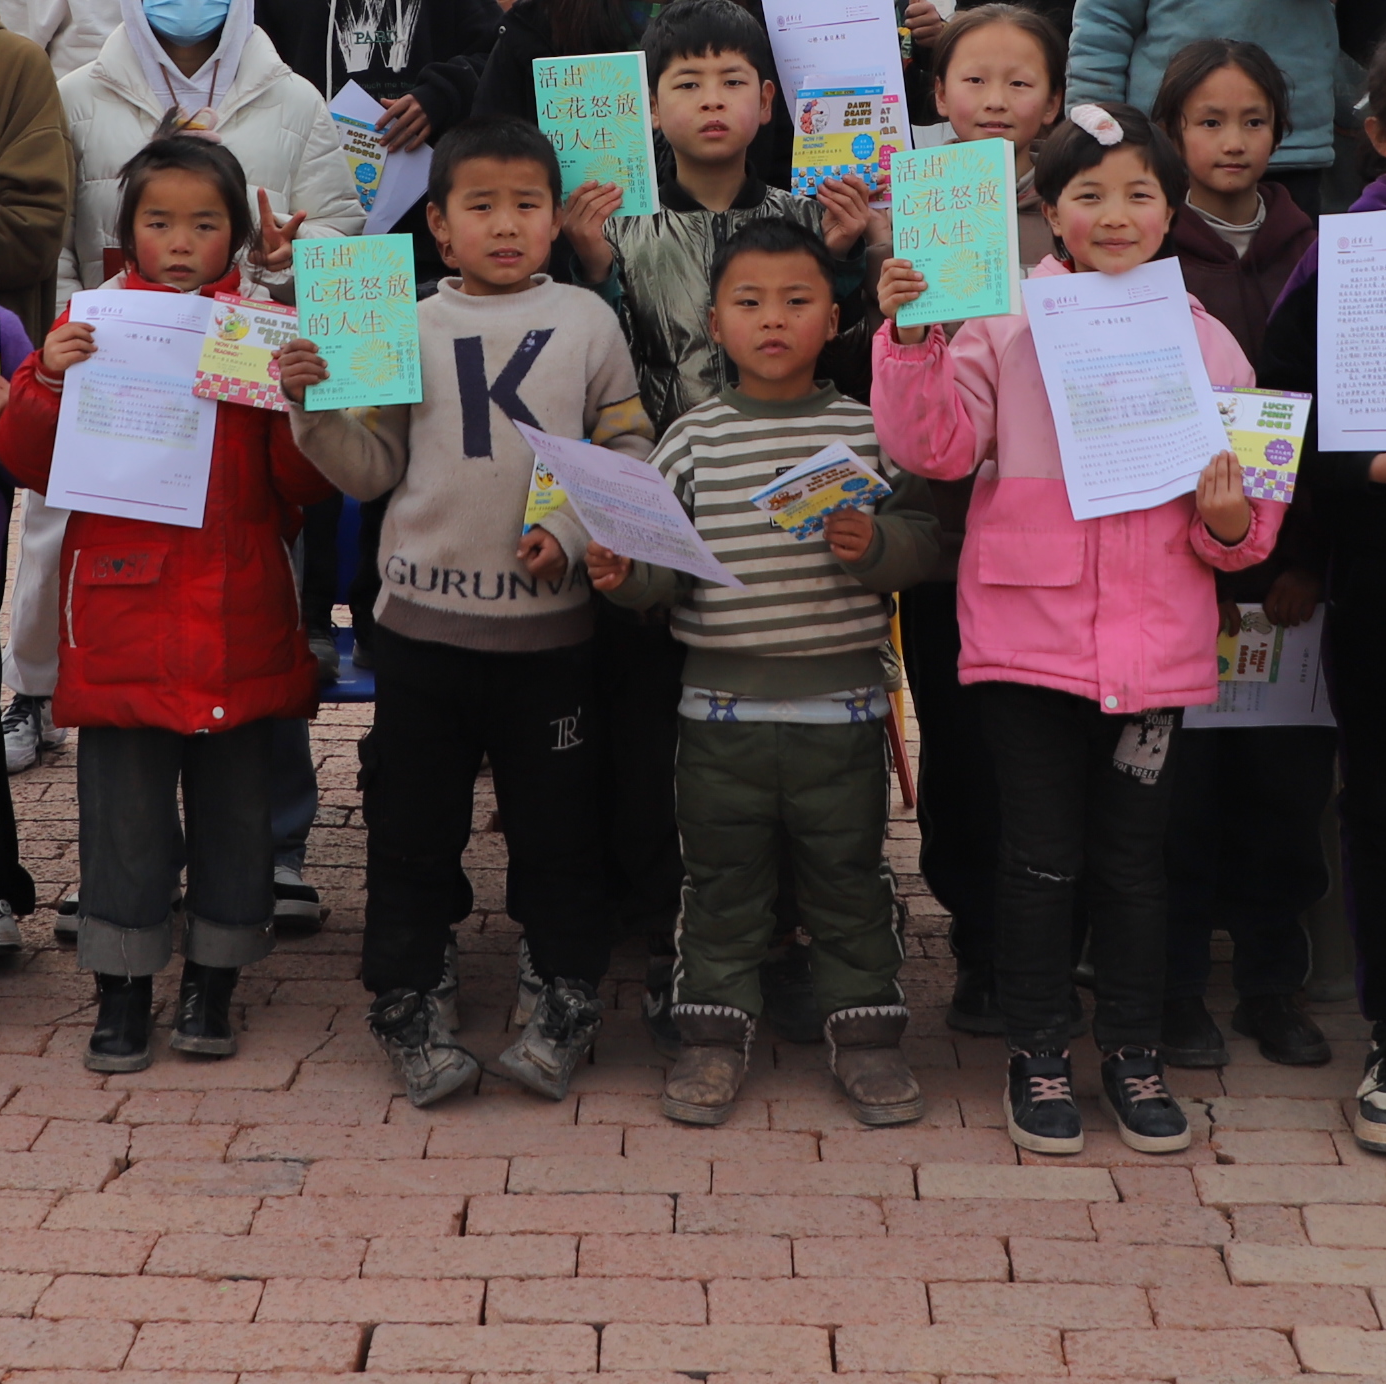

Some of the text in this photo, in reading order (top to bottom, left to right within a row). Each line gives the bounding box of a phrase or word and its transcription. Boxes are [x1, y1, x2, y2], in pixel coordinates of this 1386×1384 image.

[538, 65, 583, 89] 活出
[542, 93, 638, 120] 心花怒放
[844, 108, 872, 117] DRAWS
[847, 101, 871, 109] DAWN
[352, 138, 376, 150] SPORT
[546, 127, 616, 152] 的人生
[896, 155, 944, 183] 活出
[897, 180, 999, 216] 心花怒放
[899, 219, 975, 251] 的人生
[304, 244, 353, 270] 活出
[306, 273, 410, 303] 心花怒放
[308, 310, 385, 337] 的人生
[1261, 410, 1293, 419] PENNY
[1263, 402, 1294, 410] LUCKY
